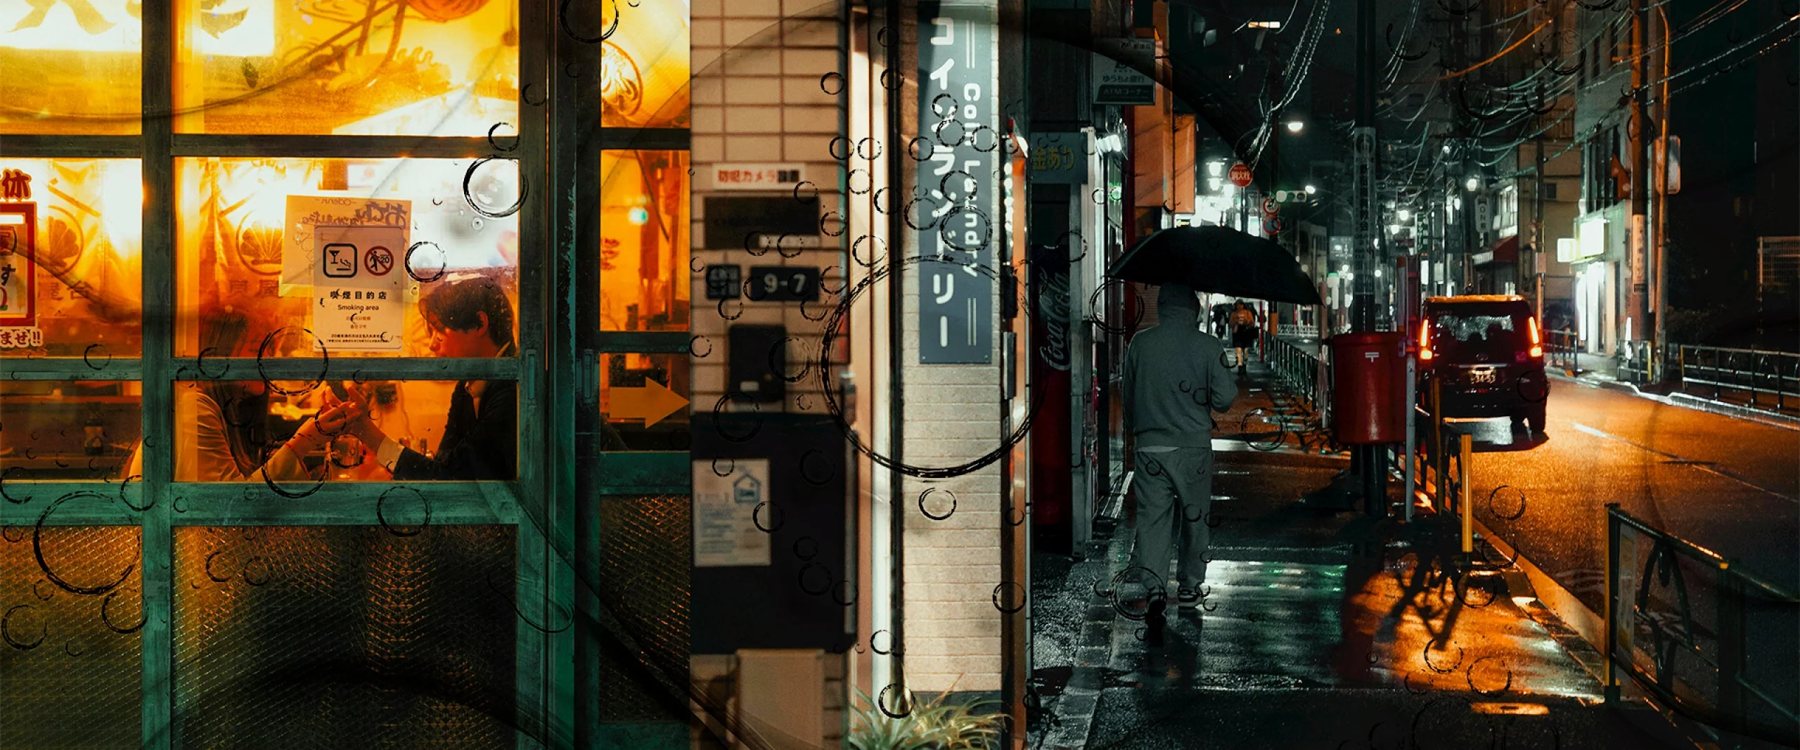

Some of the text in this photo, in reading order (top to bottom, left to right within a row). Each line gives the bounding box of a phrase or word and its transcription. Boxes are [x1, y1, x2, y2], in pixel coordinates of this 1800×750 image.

[963, 83, 981, 146] Coin
[930, 17, 956, 347] コインランドリー
[763, 272, 807, 294] 9-7
